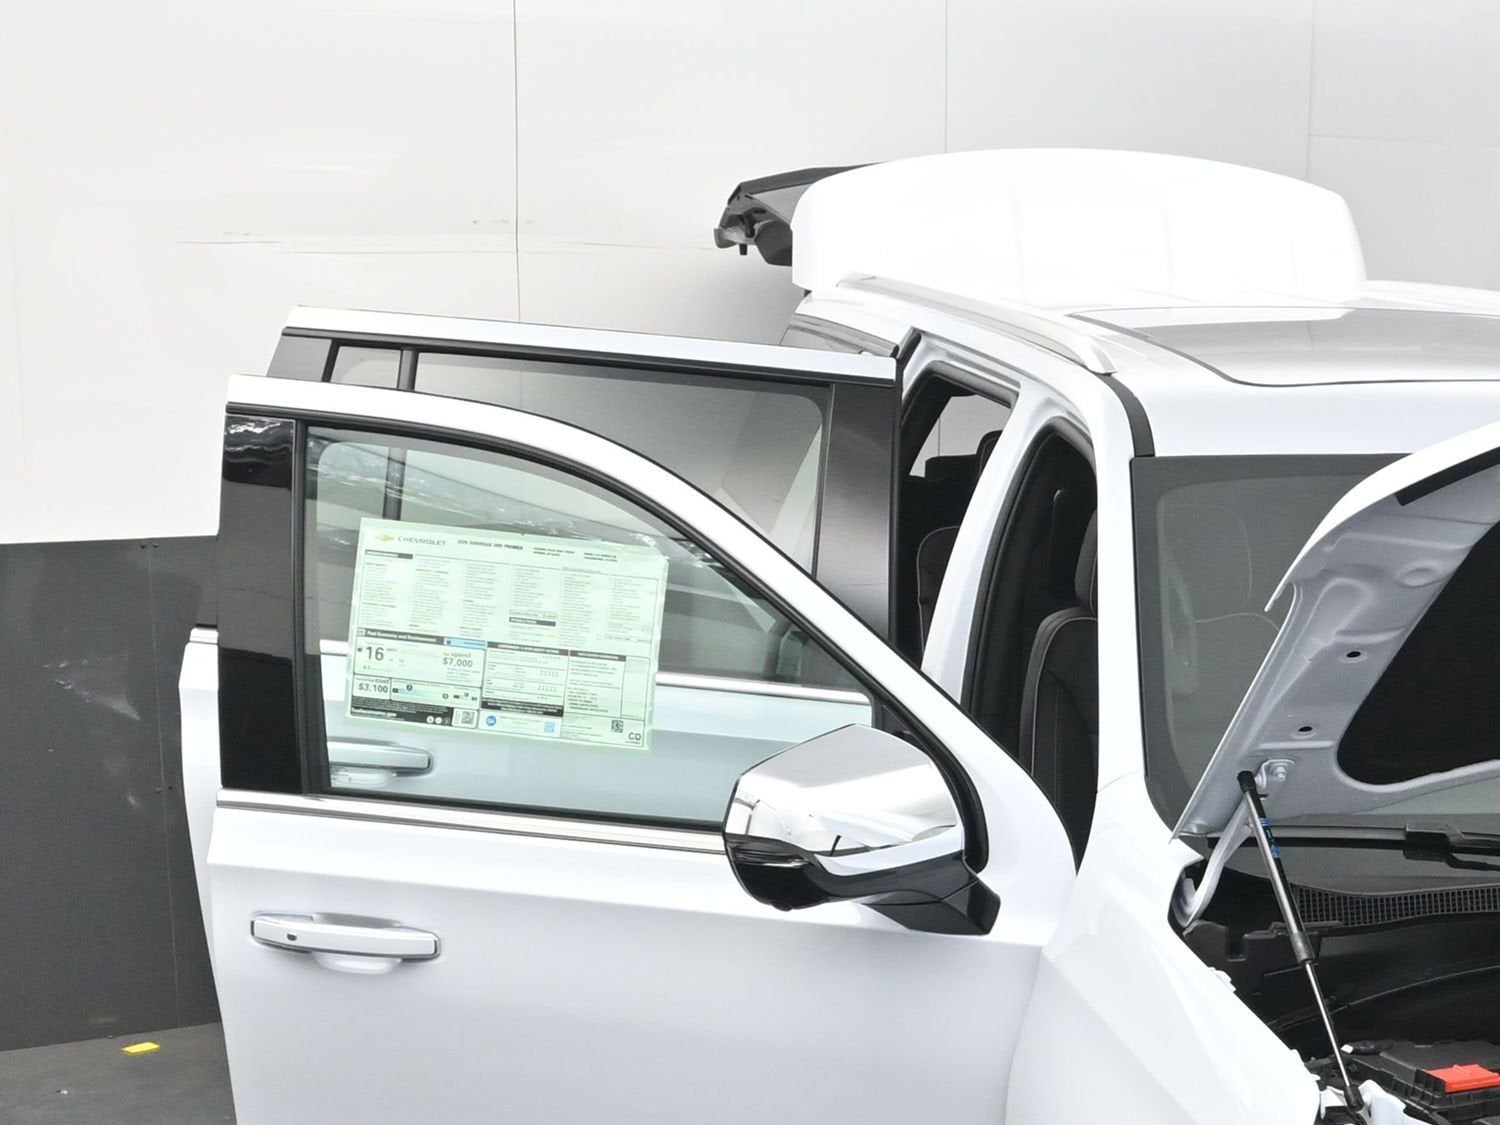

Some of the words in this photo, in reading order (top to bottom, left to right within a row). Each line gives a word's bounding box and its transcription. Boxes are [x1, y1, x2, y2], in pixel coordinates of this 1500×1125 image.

[397, 536, 446, 546] CHEVROLET
[378, 631, 397, 639] Economy
[366, 646, 384, 661] 16
[451, 651, 472, 659] spend
[442, 657, 473, 668] $7,000
[358, 682, 388, 694] $3,100
